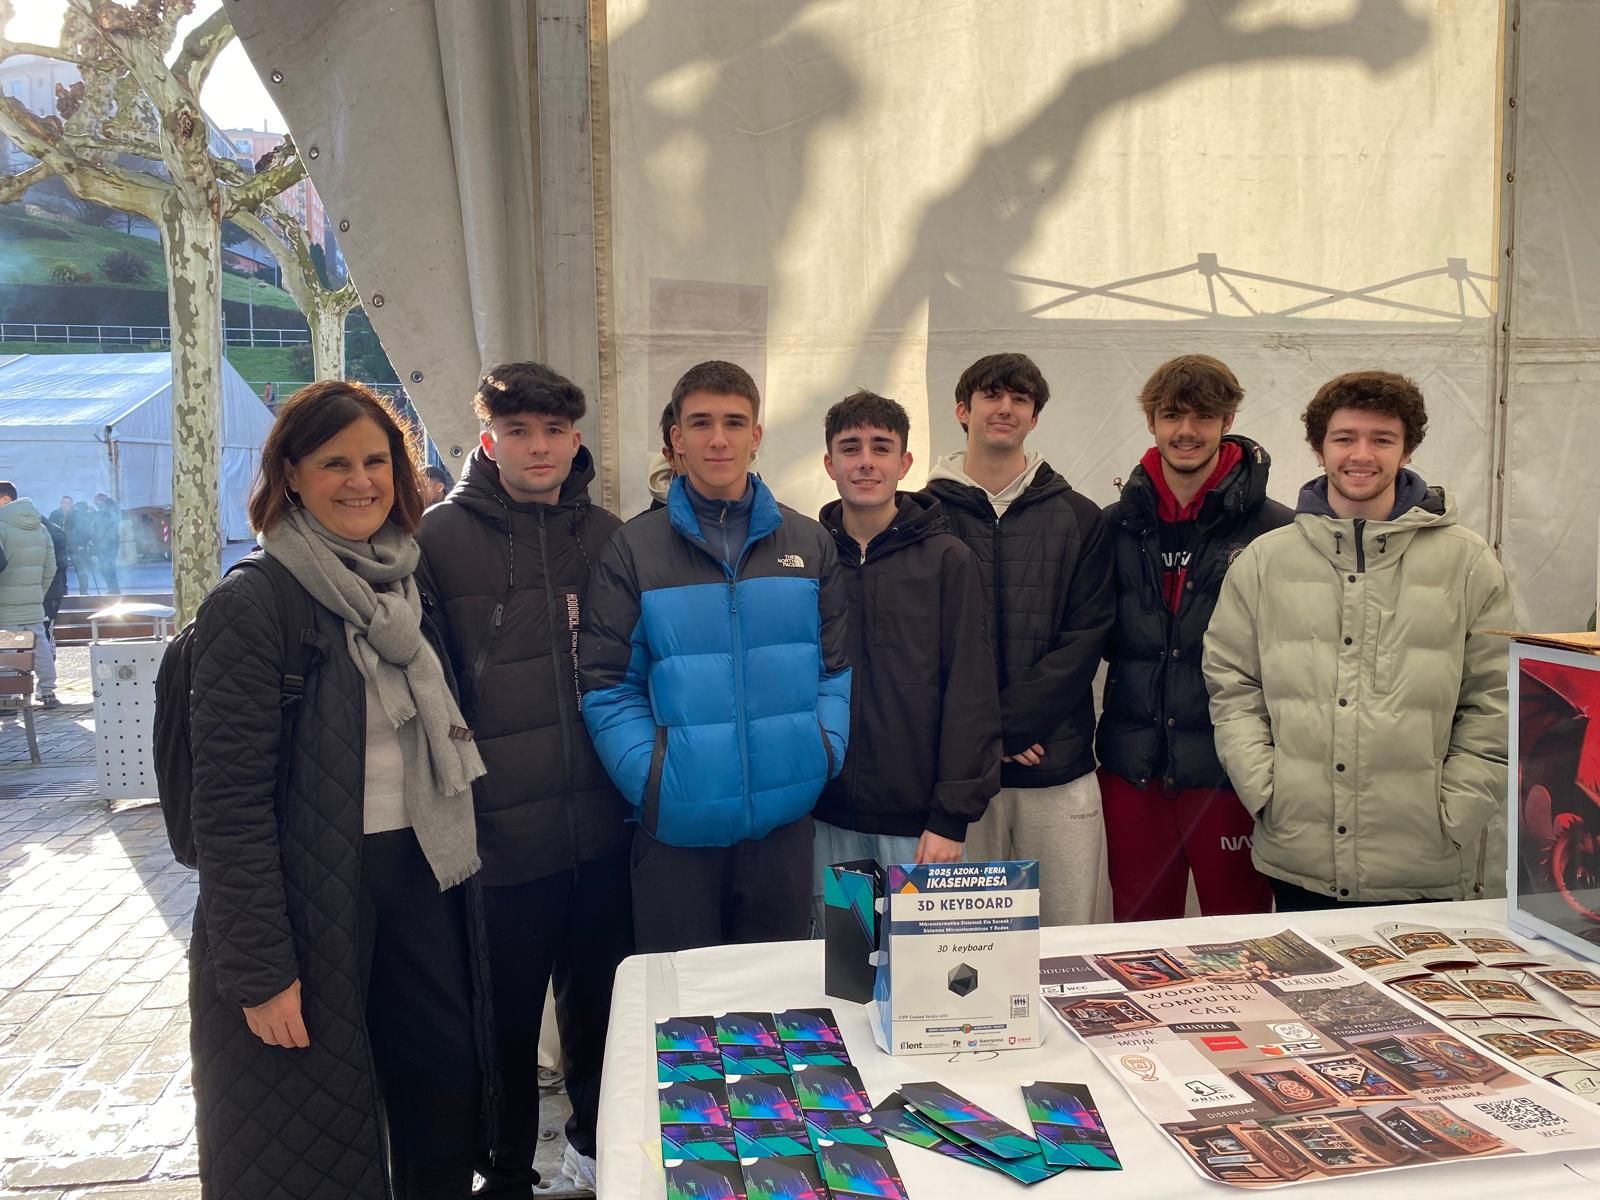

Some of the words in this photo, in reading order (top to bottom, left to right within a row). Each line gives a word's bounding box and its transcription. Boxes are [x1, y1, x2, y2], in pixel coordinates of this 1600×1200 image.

[566, 594, 579, 625] HOODRICH
[1220, 836, 1252, 851] NA
[928, 868, 951, 877] 2025
[953, 867, 979, 875] AZOKA
[984, 866, 1006, 875] FERIA
[926, 876, 1007, 889] IKASENPRESA
[918, 900, 935, 911] 3D
[940, 897, 1013, 911] KEYBOARD
[952, 942, 994, 954] keyboard
[1039, 966, 1092, 975] ODUKTUA
[1142, 984, 1233, 999] WOODEN
[1148, 994, 1257, 1010] COMPUTER
[1190, 1005, 1241, 1015] CASE
[1175, 1023, 1231, 1031] ALIANTZAK
[1104, 1030, 1155, 1040] SALKETA
[1118, 1039, 1158, 1047] MOTAK
[1281, 1042, 1323, 1051] PC
[1421, 1086, 1448, 1095] GURE
[1449, 1084, 1472, 1092] WEB
[1191, 1093, 1237, 1103] ONLINE
[1428, 1091, 1485, 1102] ORRIALDEA
[1207, 1107, 1258, 1119] DISEINUAK
